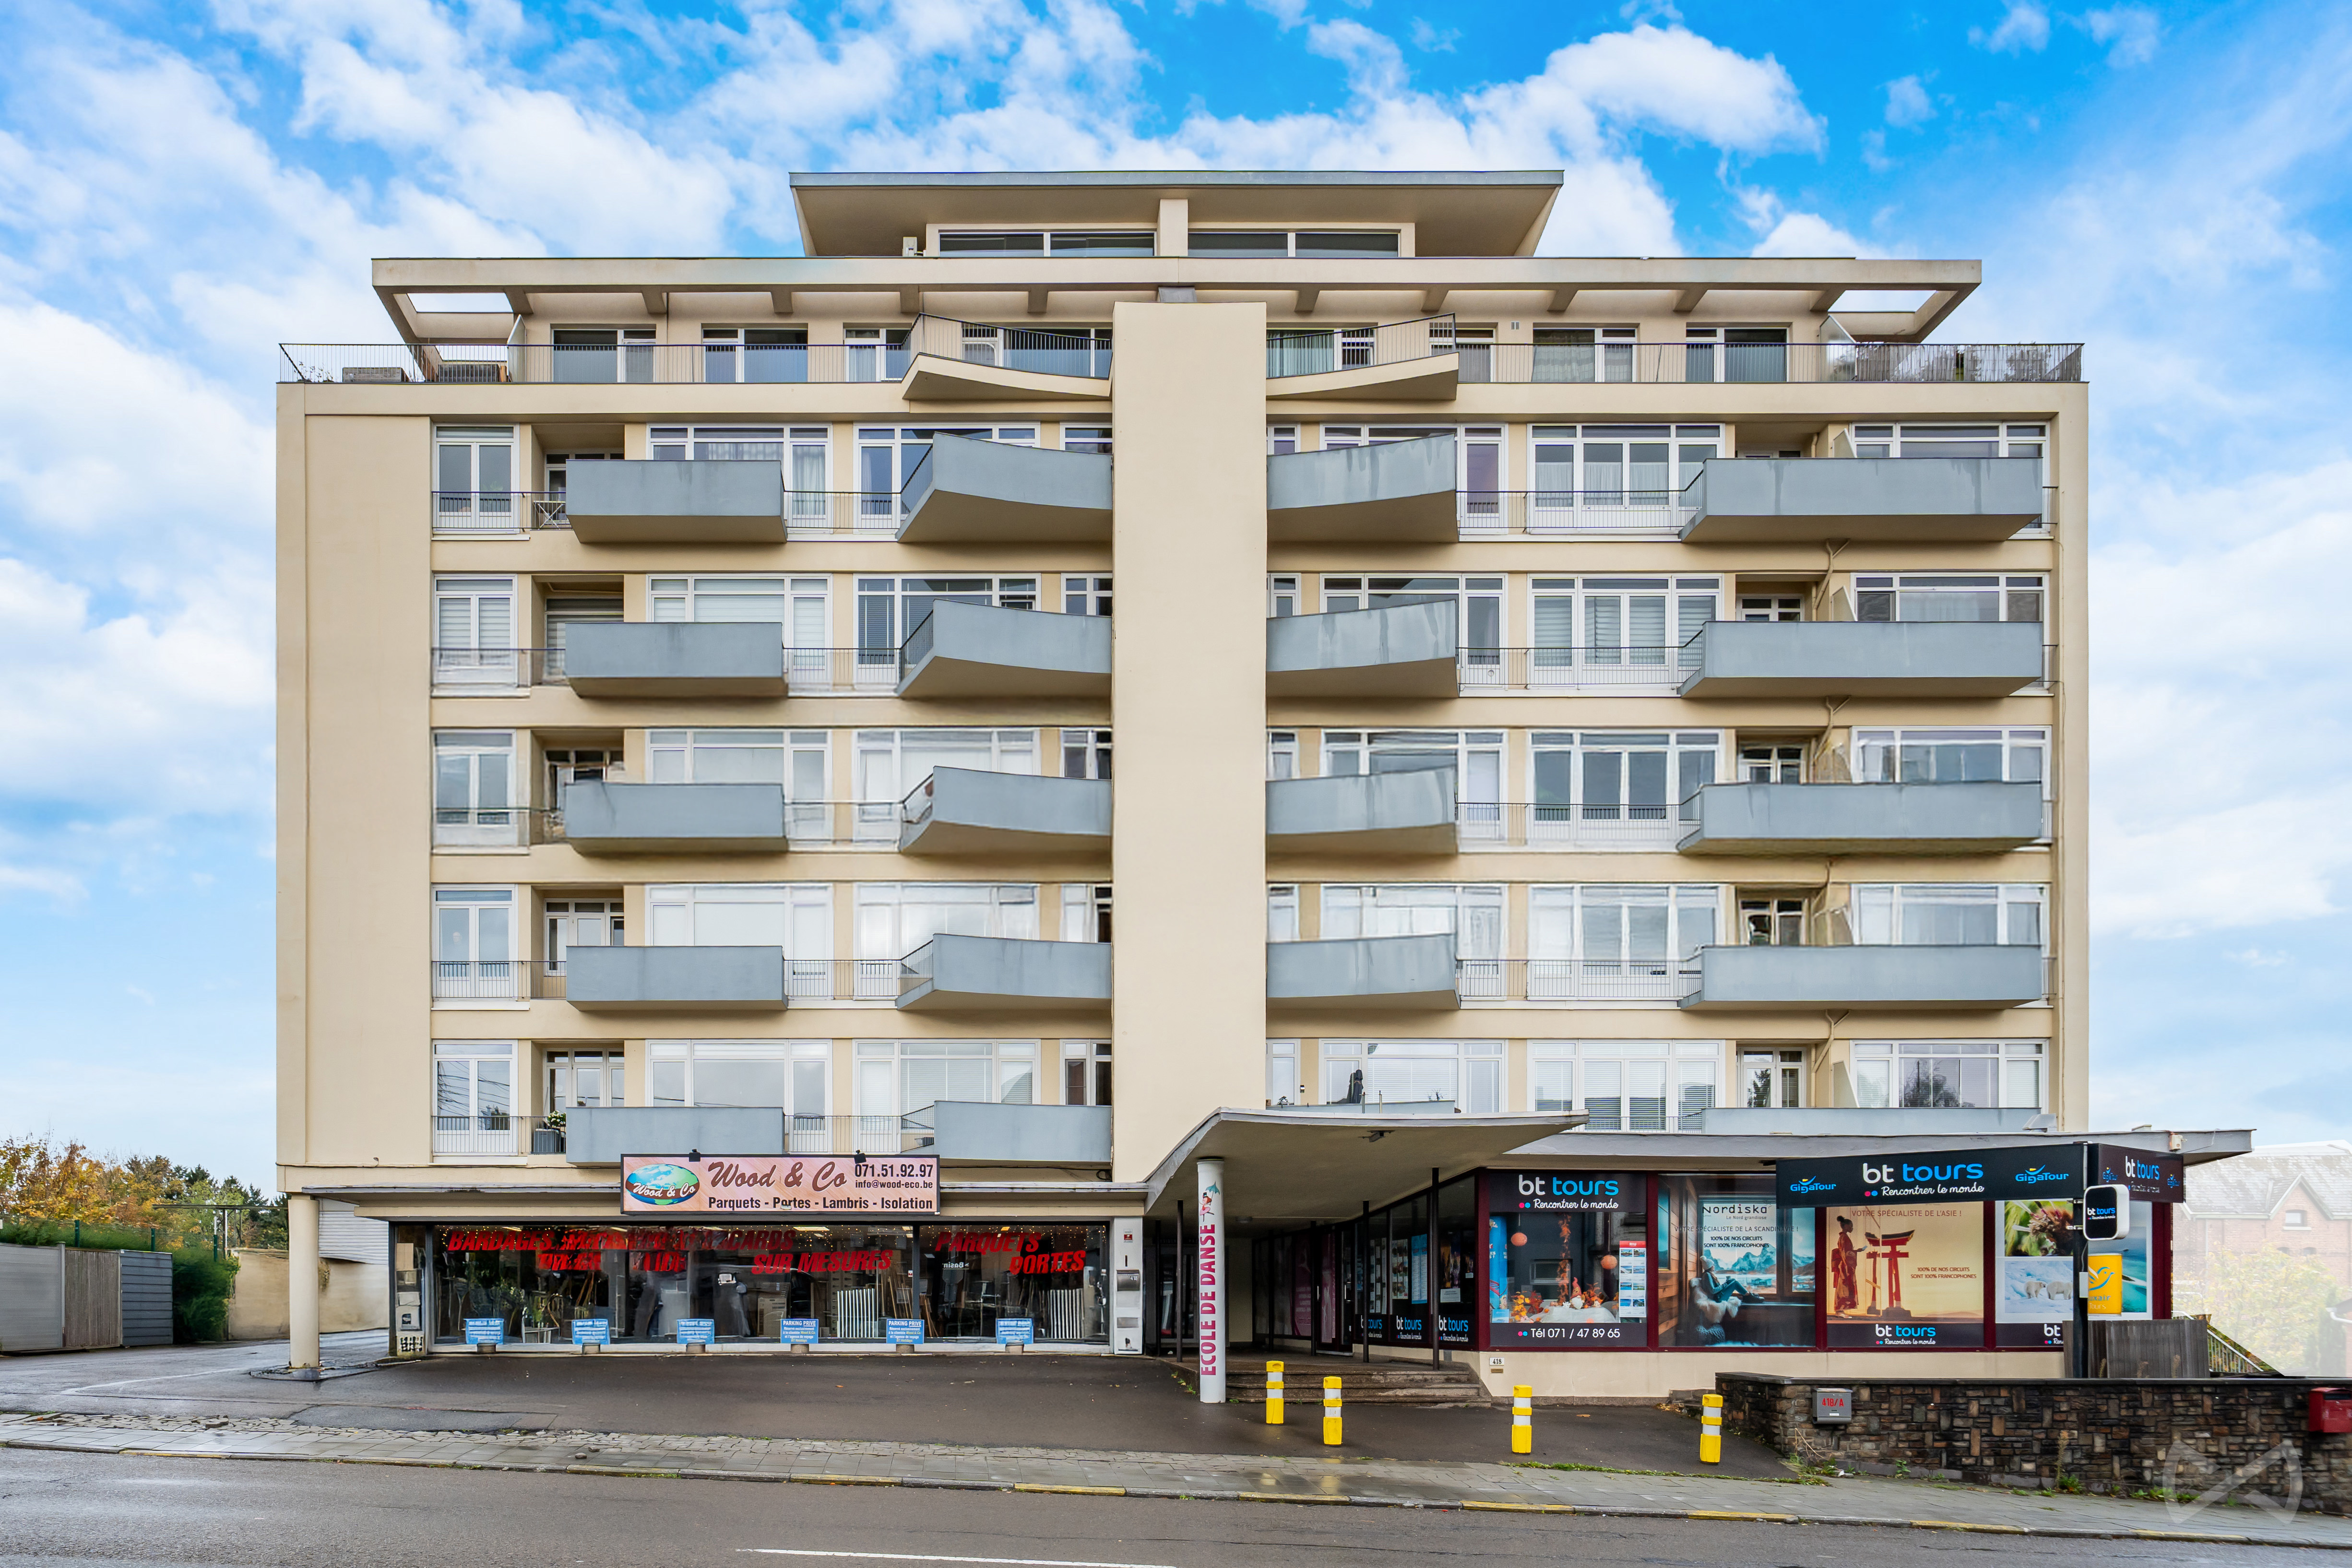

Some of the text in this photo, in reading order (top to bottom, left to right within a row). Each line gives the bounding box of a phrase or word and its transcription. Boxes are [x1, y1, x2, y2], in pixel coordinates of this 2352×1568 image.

[855, 1164, 933, 1177] 071.51.92.97
[1863, 1163, 1983, 1184] bt tours
[2126, 1155, 2160, 1180] bt tours
[708, 1162, 847, 1191] Wood & Co
[855, 1179, 933, 1188] info@wood-eco.be
[2016, 1172, 2069, 1183] GigaTour
[633, 1182, 696, 1197] Wood & Co
[1519, 1174, 1619, 1195] bt tours
[1790, 1183, 1836, 1193] GigaTour
[1881, 1182, 1984, 1196] Rencontrer le monde
[709, 1197, 760, 1211] Parquets
[773, 1197, 810, 1209] Portes
[823, 1197, 869, 1209] Lambris
[881, 1197, 932, 1209] Isolation
[1533, 1198, 1618, 1208] Rencontrer le monde
[1702, 1204, 1767, 1213] Nordiska
[448, 1231, 555, 1251] BARDAGES
[935, 1232, 1042, 1255] PARQUETS
[752, 1250, 892, 1274] SUR MESURES
[1009, 1250, 1086, 1275] PORTES
[1200, 1224, 1216, 1375] ECOLE DE DANSE
[1368, 1319, 1382, 1329] ours
[1396, 1315, 1422, 1330] bt tours
[1438, 1315, 1468, 1331] bt tours
[2044, 1323, 2061, 1336] bt
[1531, 1328, 1620, 1339] Tél 071 / 47 89 65
[1876, 1324, 1936, 1337] bt tours
[1822, 1398, 1844, 1407] 418/A
